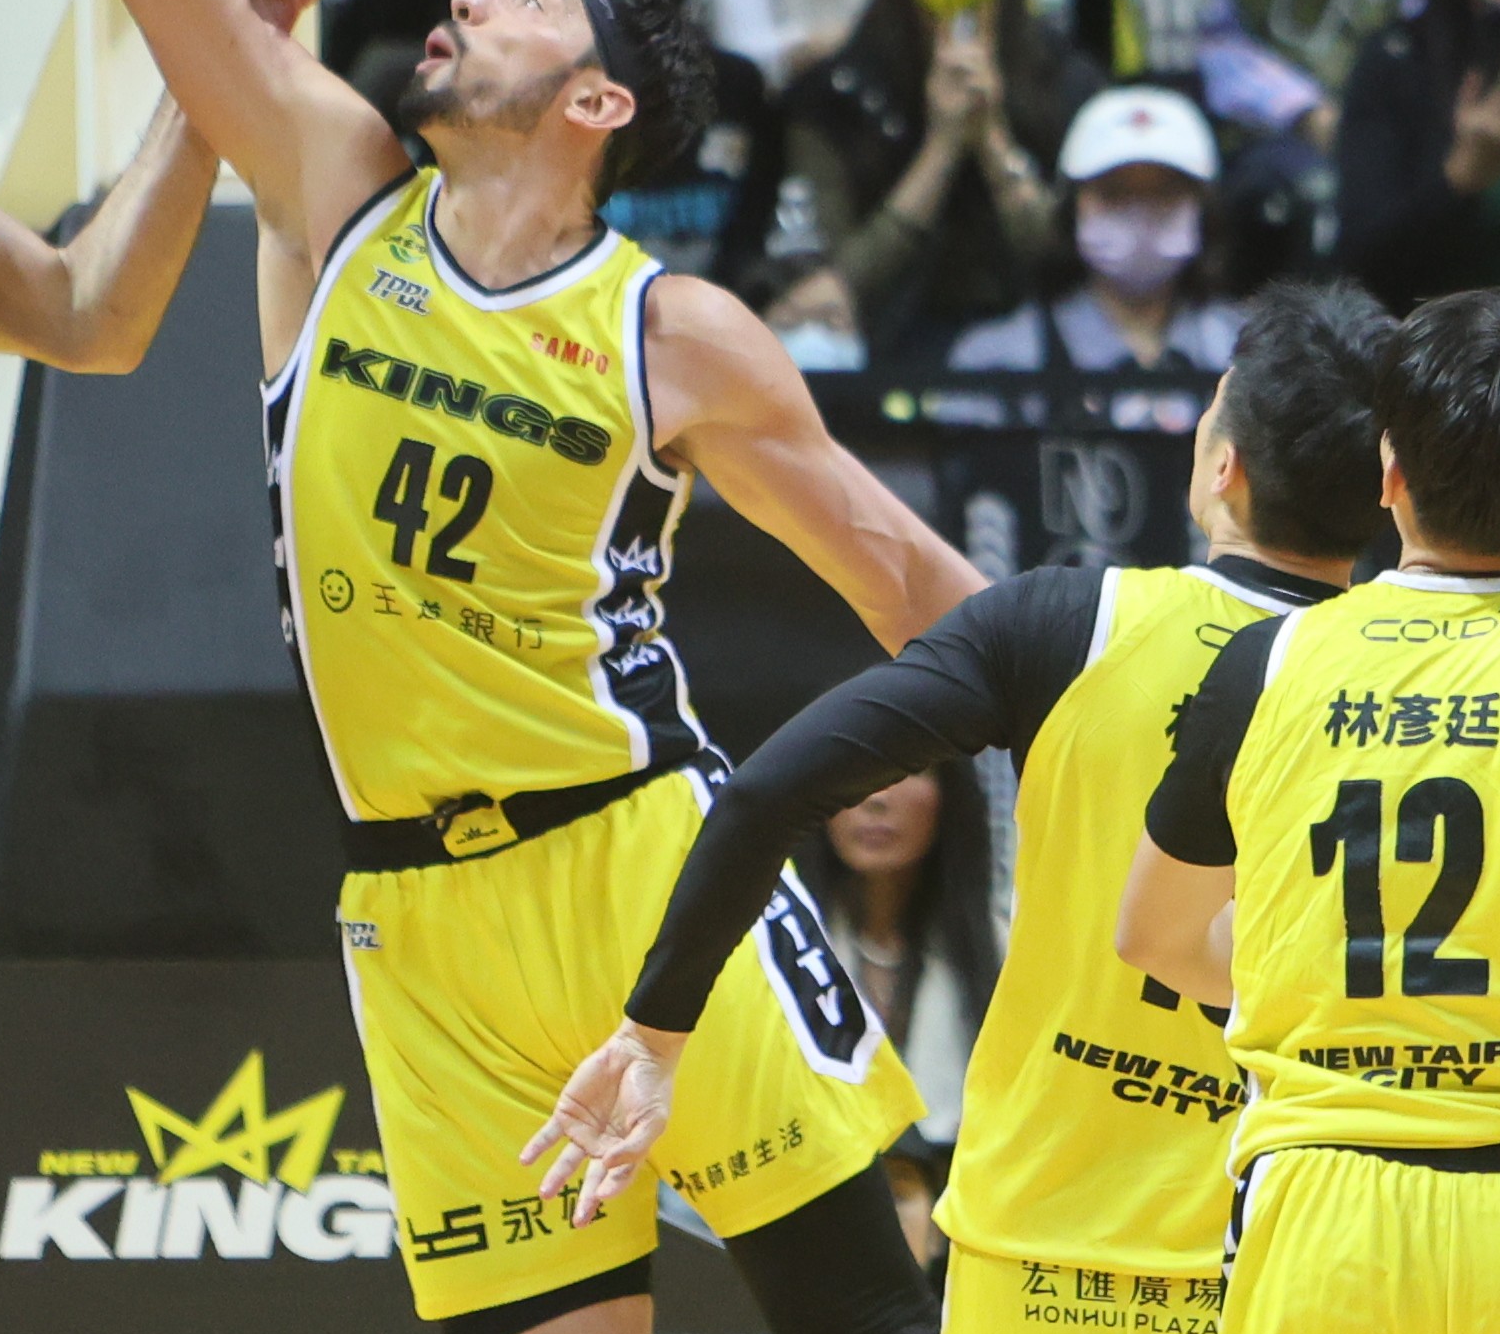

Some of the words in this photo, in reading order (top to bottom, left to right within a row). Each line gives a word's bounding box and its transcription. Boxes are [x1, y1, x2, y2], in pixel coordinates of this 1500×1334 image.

[530, 332, 609, 376] SAMPO
[320, 338, 612, 466] KINGS
[372, 437, 495, 584] 42
[1310, 776, 1490, 999] 12
[1053, 1032, 1162, 1079] NEW
[1167, 1064, 1250, 1105] TAI
[1298, 1044, 1395, 1070] NEW
[1360, 1066, 1487, 1090] CITY
[1111, 1078, 1238, 1124] CITY
[38, 1151, 141, 1175] NEW
[1025, 1303, 1127, 1328] HONHUI
